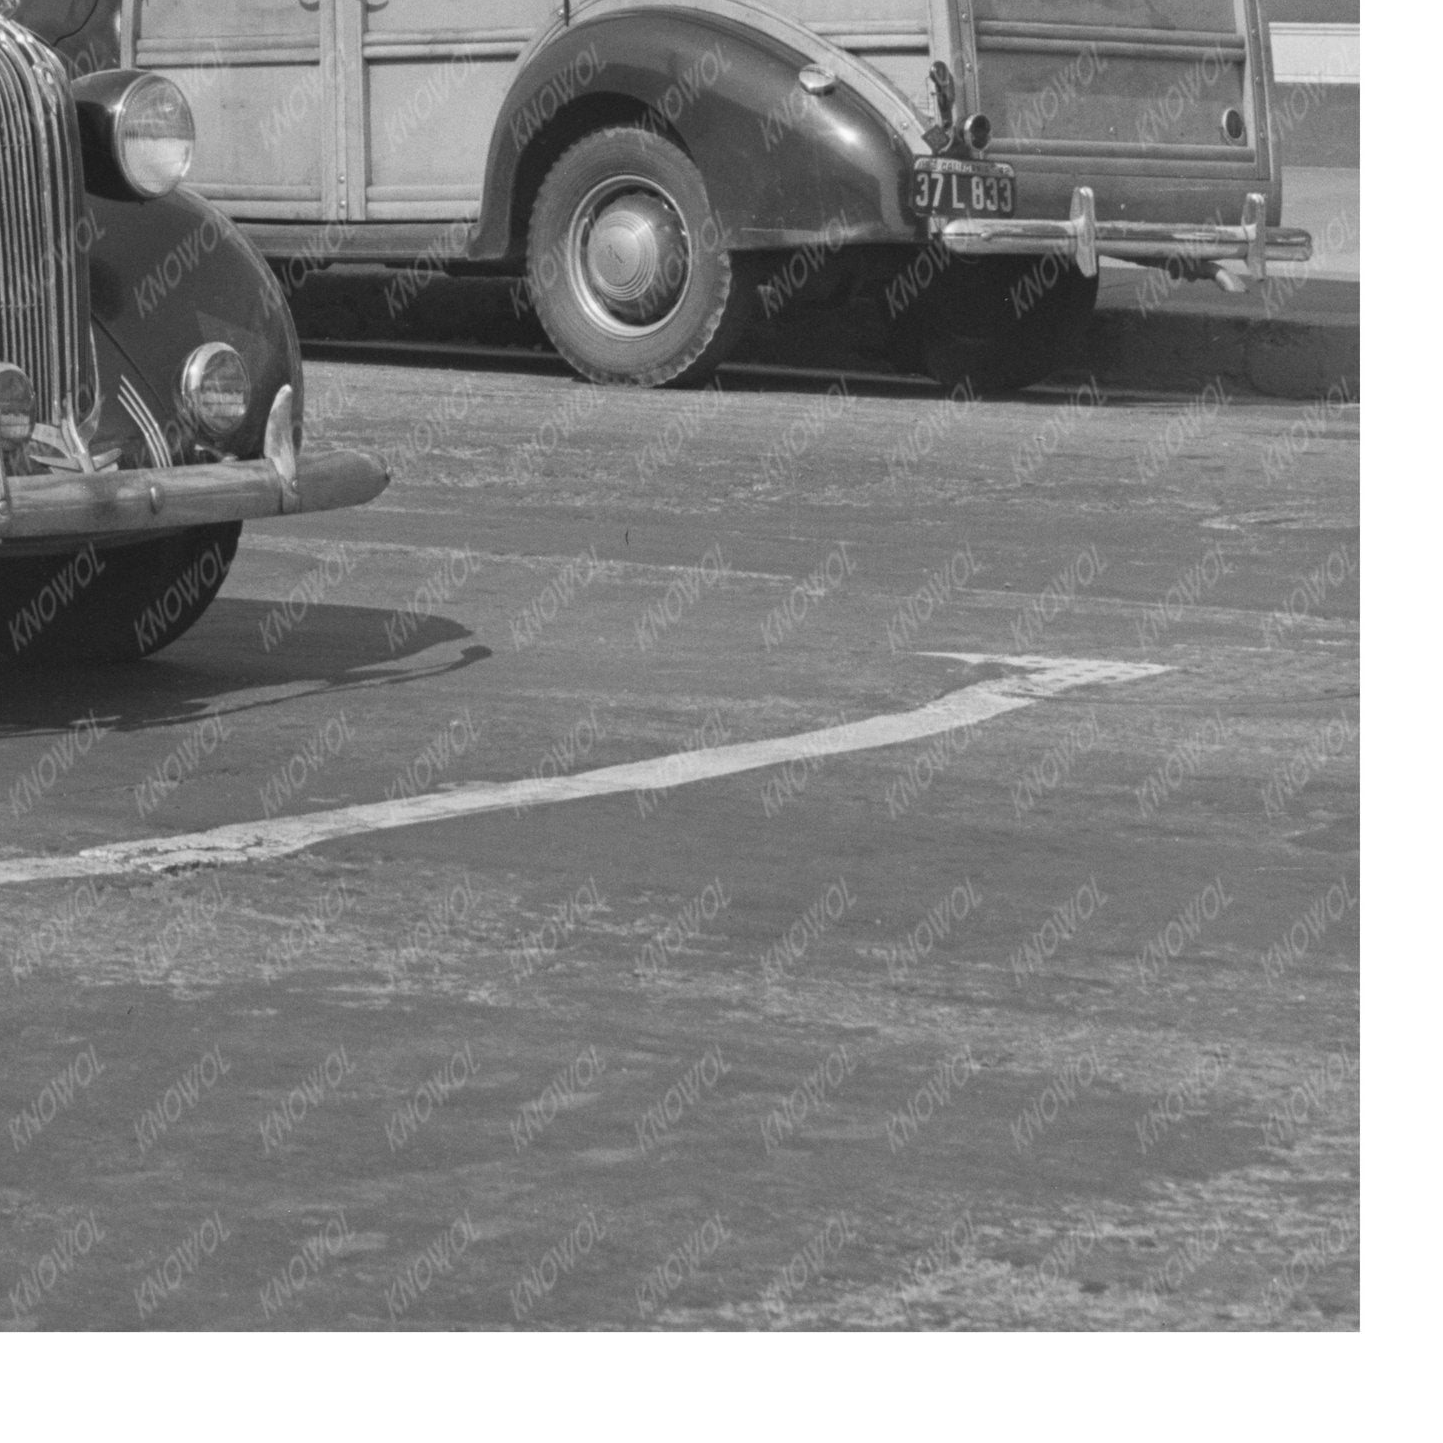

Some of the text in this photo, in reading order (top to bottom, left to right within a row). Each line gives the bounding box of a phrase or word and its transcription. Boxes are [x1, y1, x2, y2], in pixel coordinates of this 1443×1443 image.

[916, 172, 1013, 212] 37 L 833
